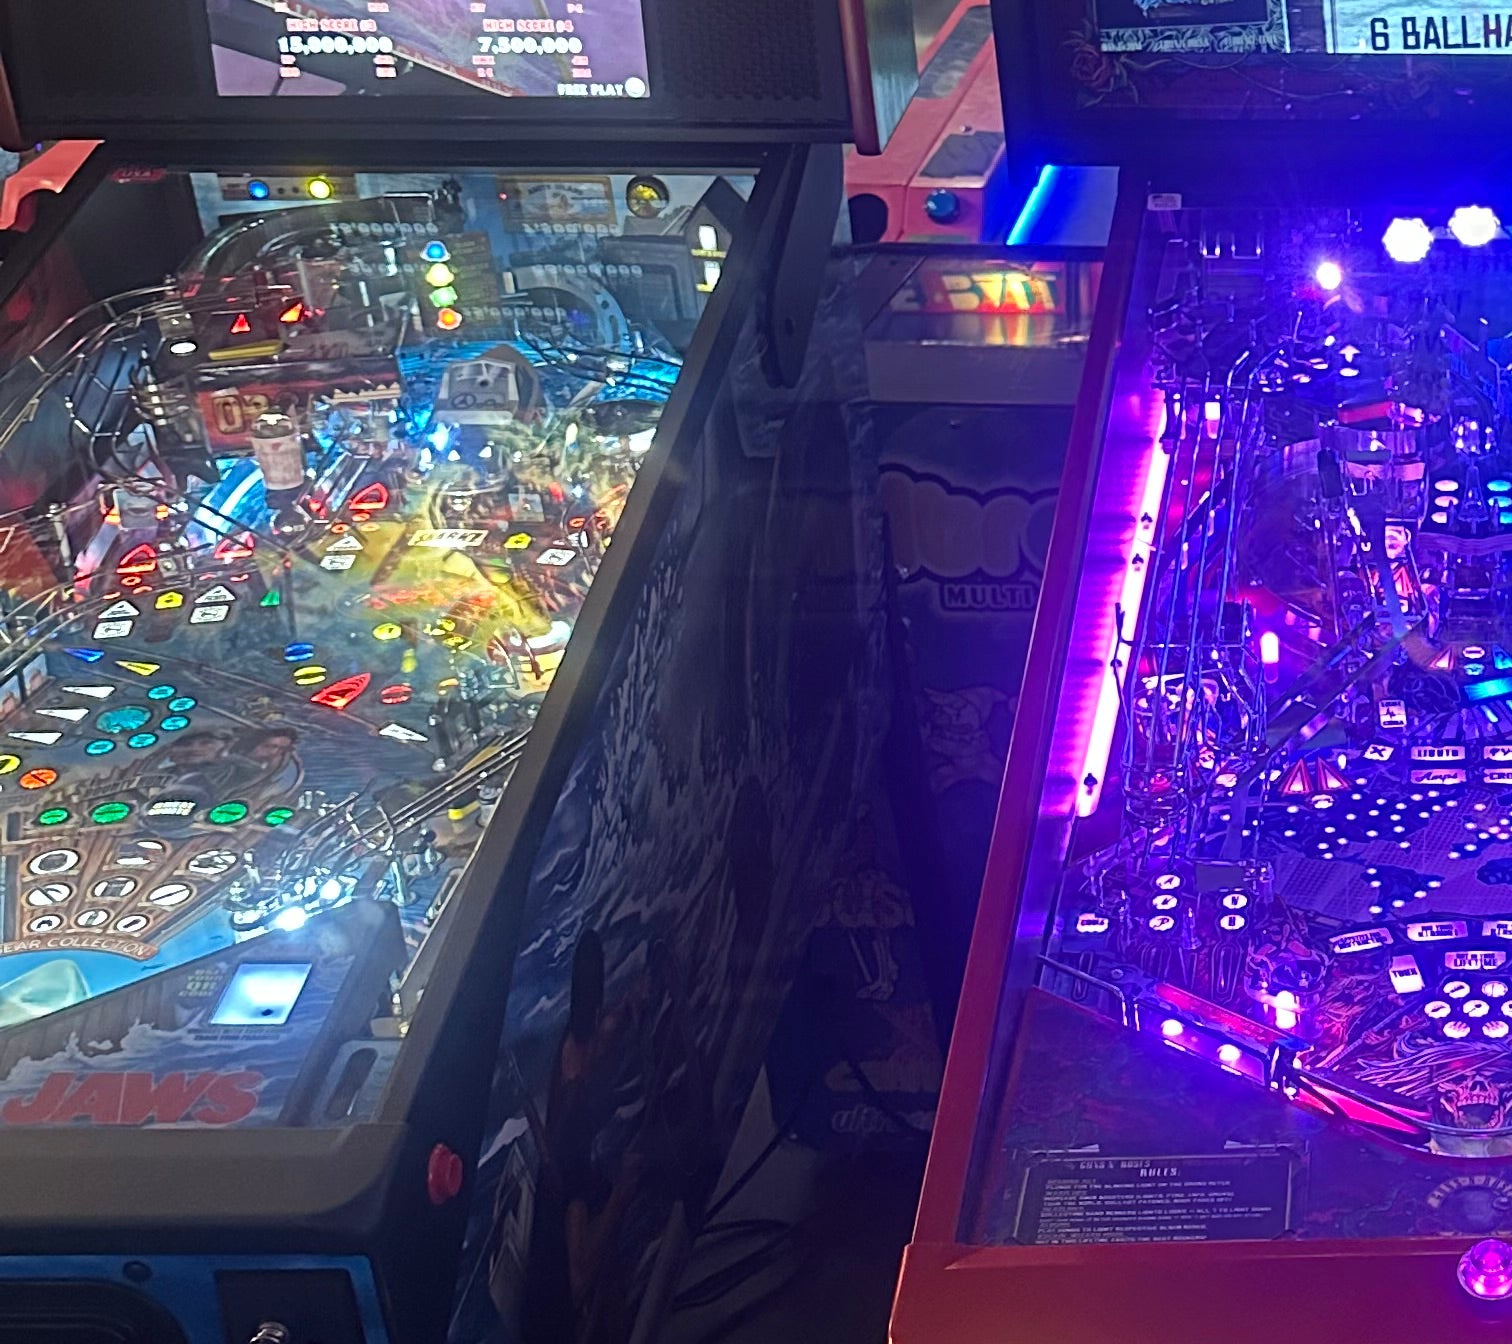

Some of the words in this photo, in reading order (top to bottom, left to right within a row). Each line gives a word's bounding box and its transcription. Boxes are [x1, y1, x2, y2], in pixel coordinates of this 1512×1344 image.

[1370, 17, 1389, 51] 6
[1401, 15, 1481, 50] BALL
[590, 83, 624, 96] PLAY
[945, 585, 1033, 608] MULTI
[47, 936, 149, 956] COLLECTION
[4, 1070, 263, 1124] JAWS
